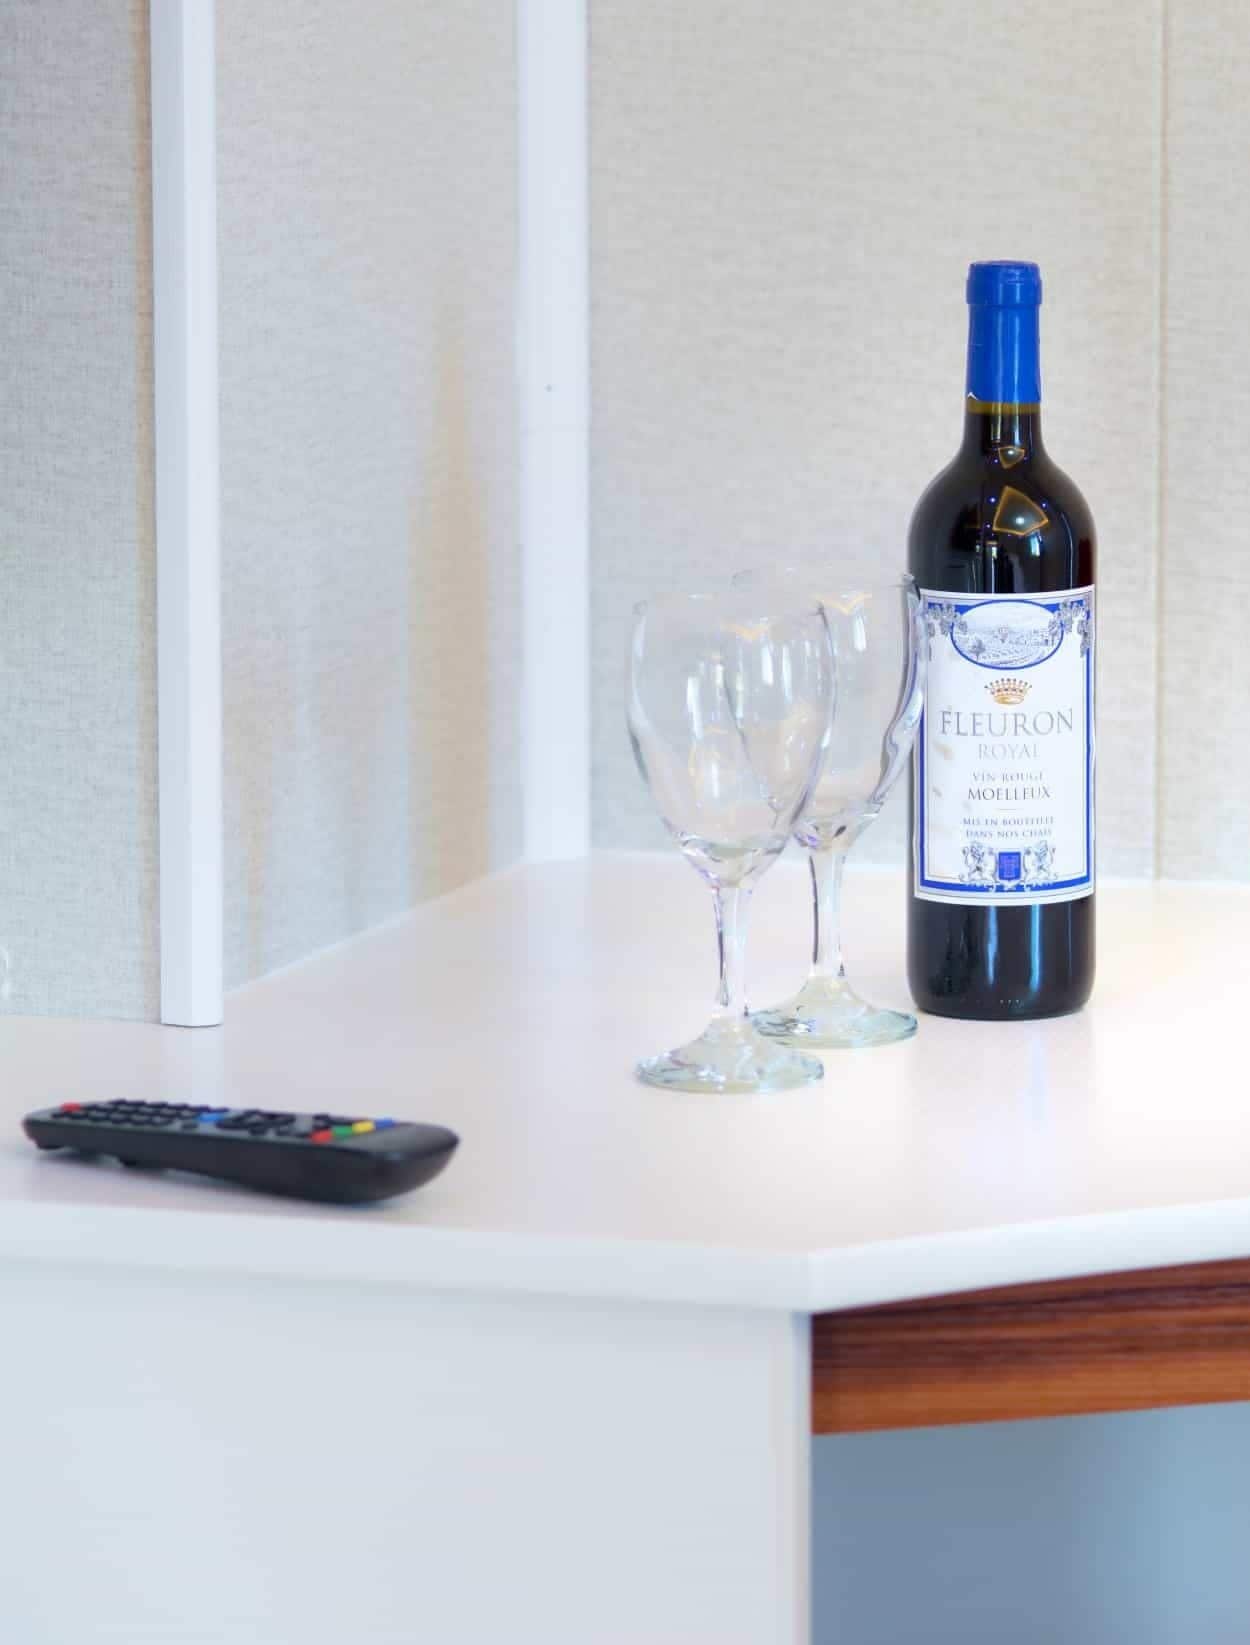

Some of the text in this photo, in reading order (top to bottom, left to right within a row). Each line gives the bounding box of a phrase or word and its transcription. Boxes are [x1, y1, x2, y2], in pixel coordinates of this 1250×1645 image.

[940, 708, 1073, 736] FLEURON
[978, 743, 1040, 760] ROYAL
[972, 771, 995, 782] VIN
[968, 786, 1050, 801] MOELLEUX
